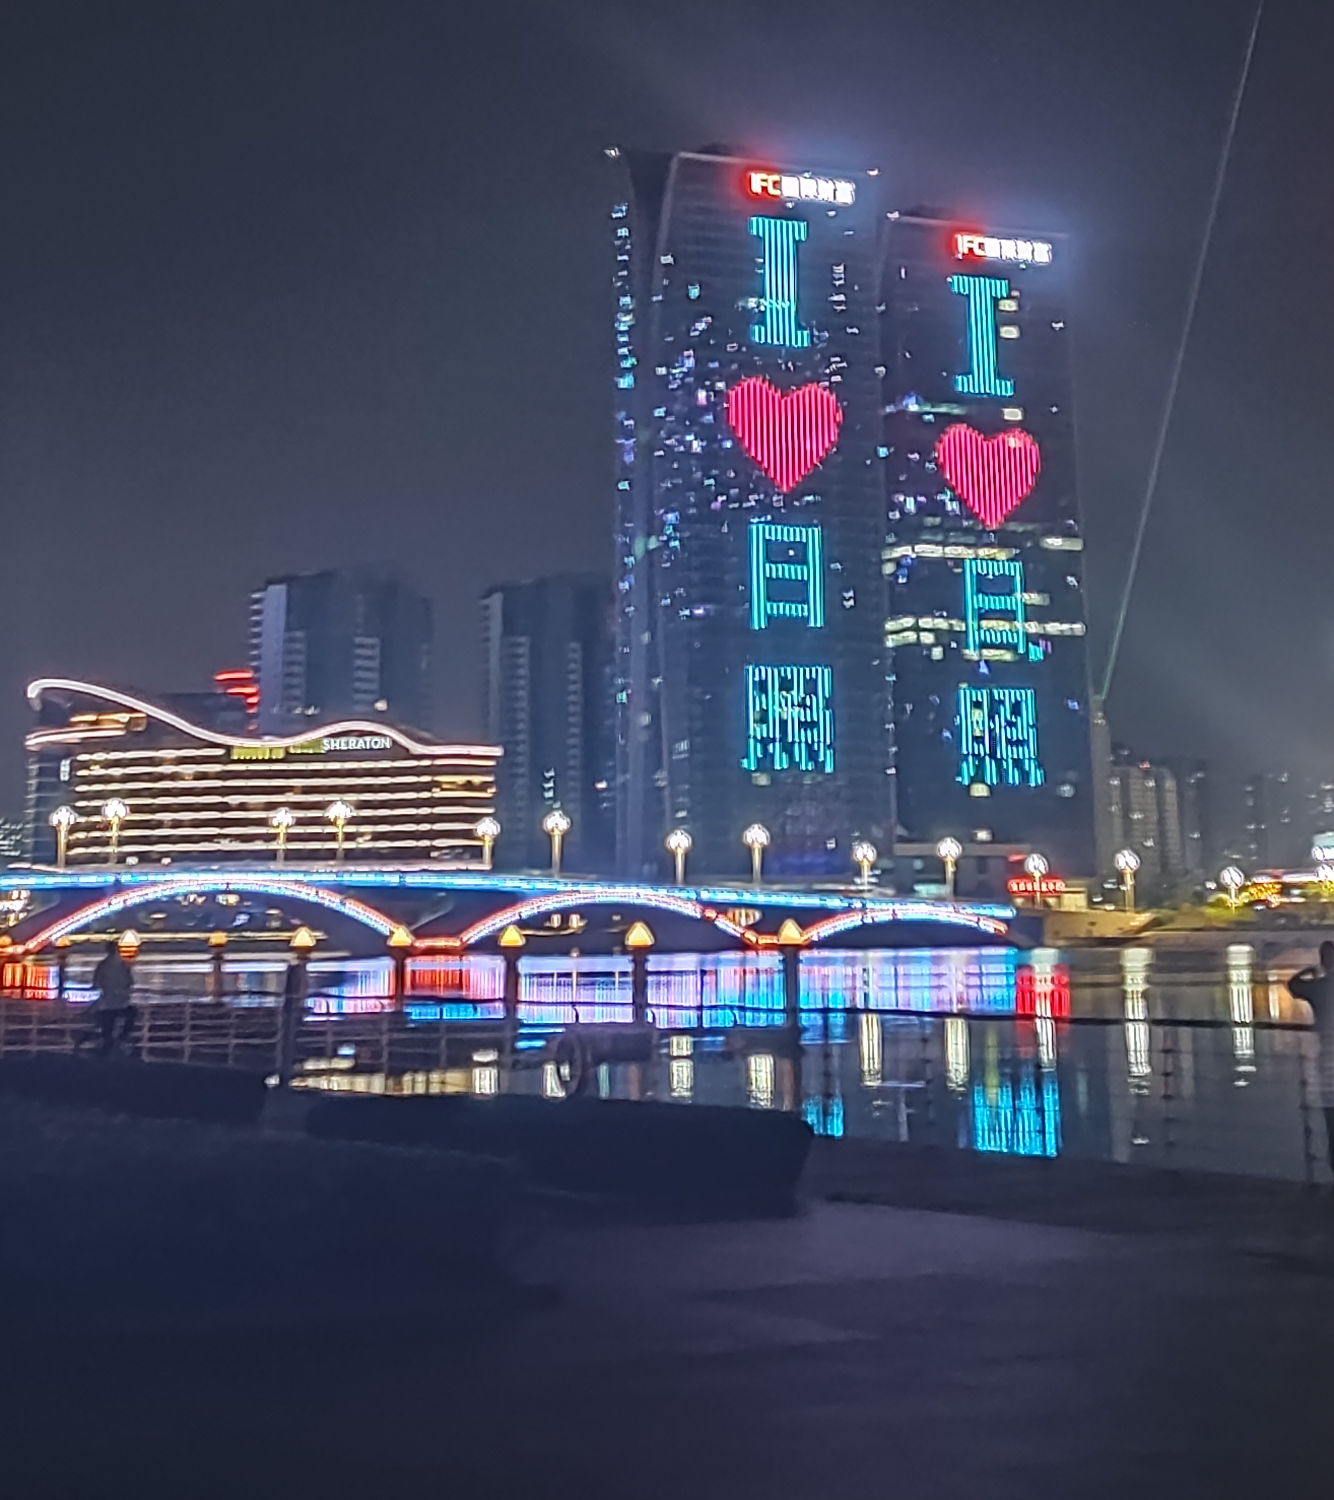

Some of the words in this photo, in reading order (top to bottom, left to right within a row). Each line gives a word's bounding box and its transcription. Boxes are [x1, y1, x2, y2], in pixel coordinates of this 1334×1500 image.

[749, 216, 809, 348] I
[949, 274, 1014, 397] I
[322, 736, 391, 751] SHERATON
